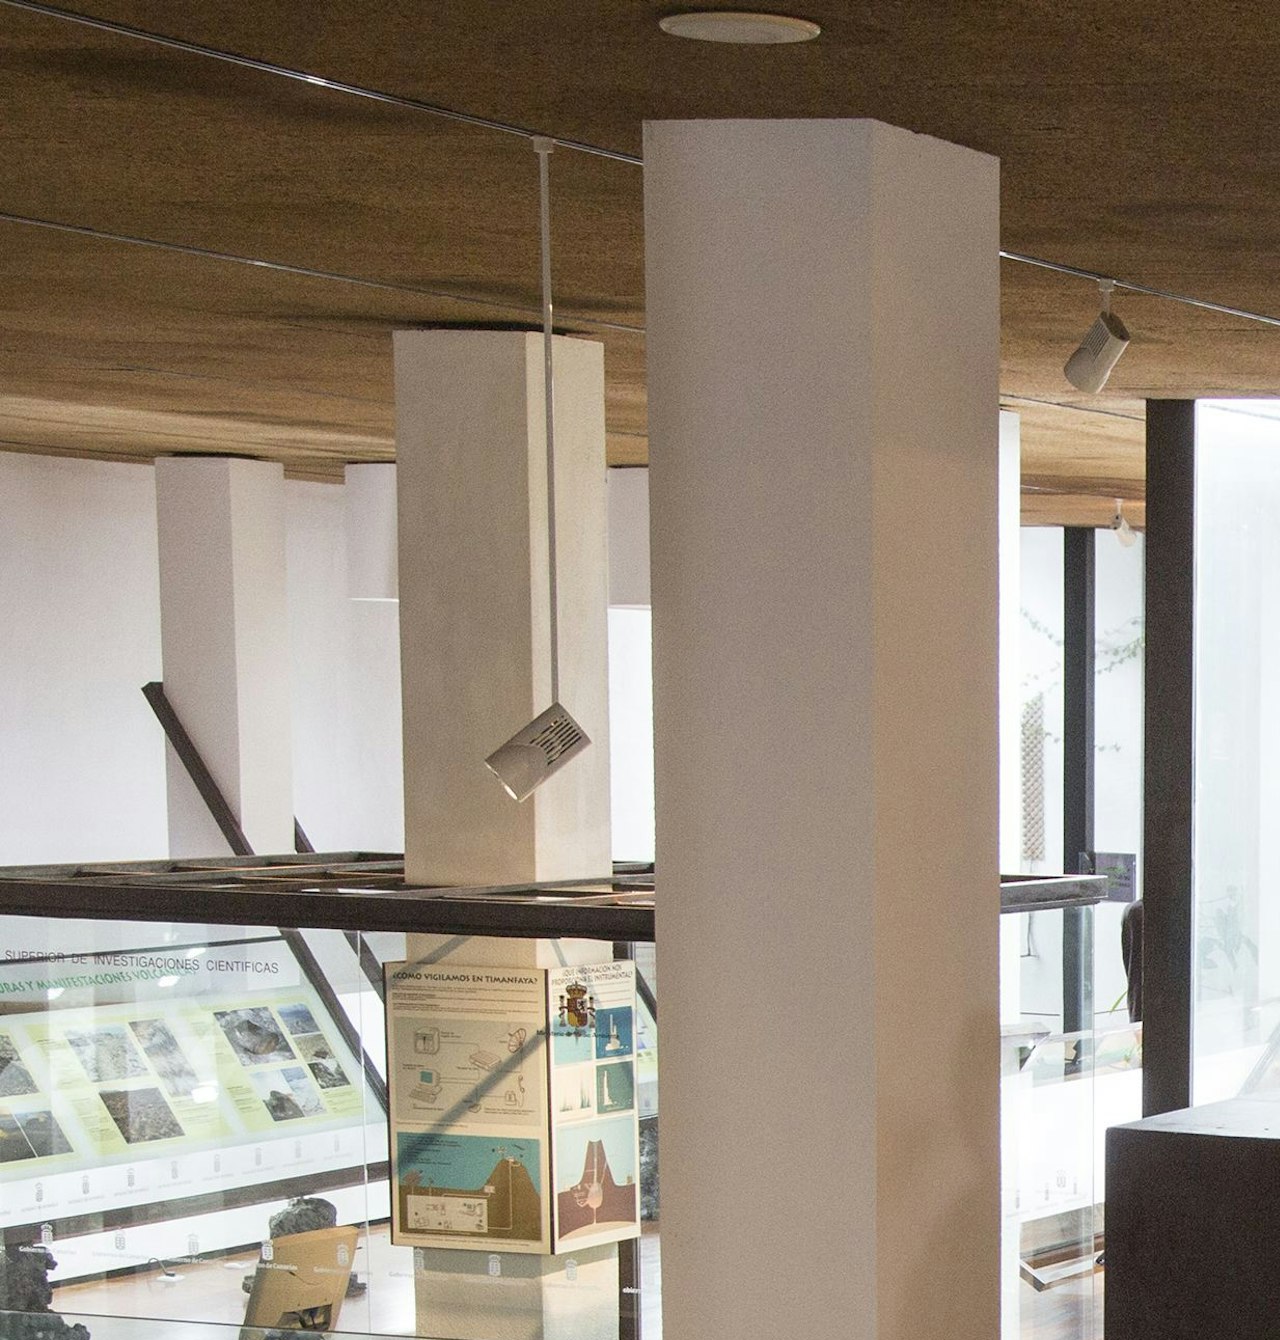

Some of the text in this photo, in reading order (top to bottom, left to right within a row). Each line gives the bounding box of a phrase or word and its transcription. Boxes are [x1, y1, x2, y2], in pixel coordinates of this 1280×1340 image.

[5, 950, 279, 974] SUPERIOR DE INVESTIGACIONES CIENTIFICAS
[26, 980, 34, 991] Y
[37, 969, 132, 991] MANIFESTACIONES
[423, 972, 471, 982] VIGILAMOS
[472, 974, 484, 983] EN
[485, 975, 538, 985] TIMANFAYA?
